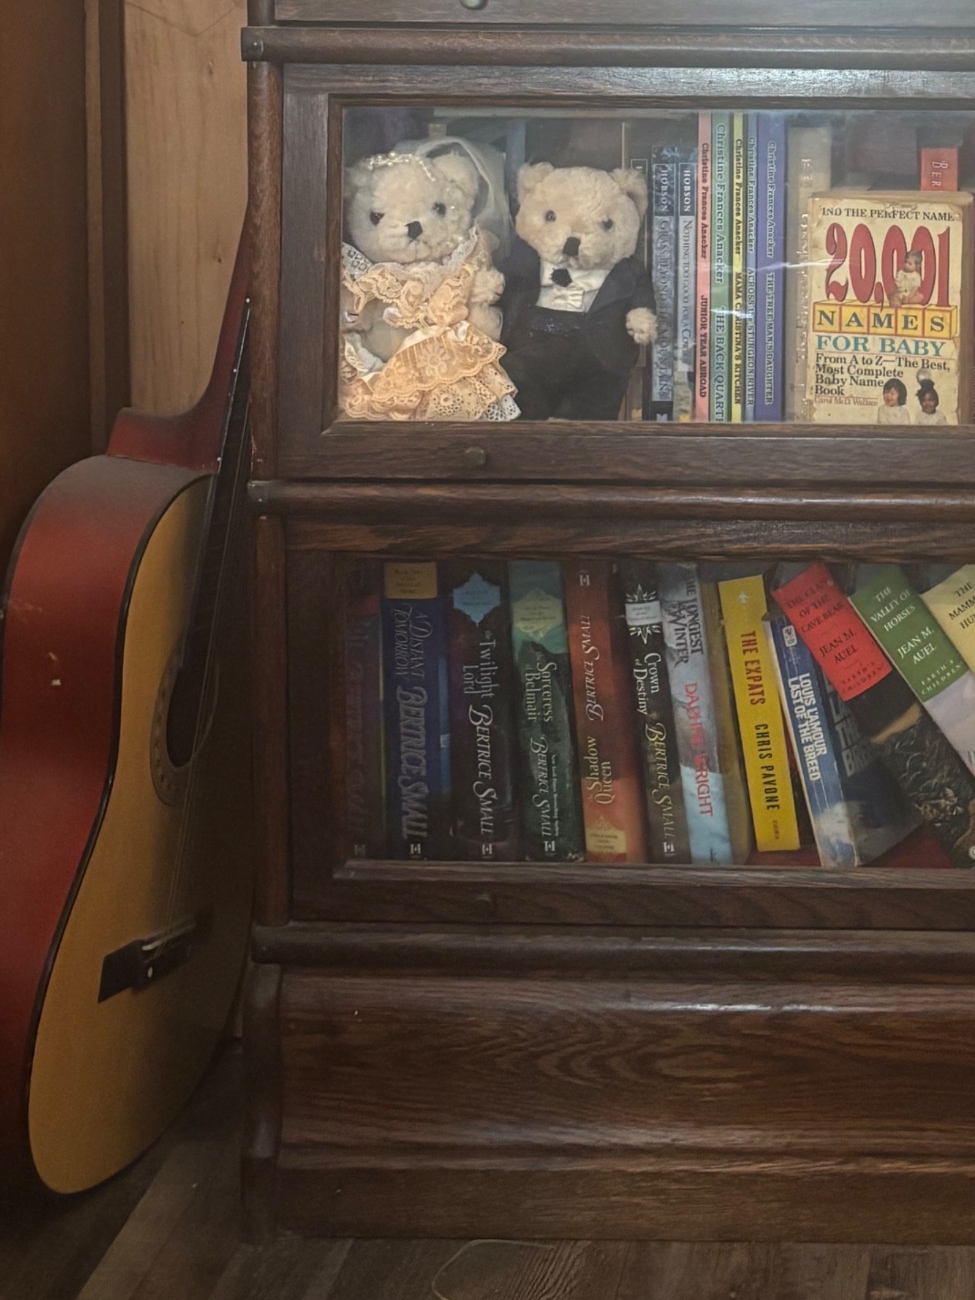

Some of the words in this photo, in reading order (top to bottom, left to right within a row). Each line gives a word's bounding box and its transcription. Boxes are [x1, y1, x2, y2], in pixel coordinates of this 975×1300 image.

[717, 124, 726, 180] Christine
[683, 169, 691, 212] HOBSON
[716, 183, 725, 231] Frances
[845, 209, 867, 217] THE
[870, 209, 920, 220] PERFECT
[716, 234, 725, 284] Anacker
[826, 223, 951, 312] 20,001
[766, 272, 775, 293] THE
[817, 310, 945, 333] NAMES
[714, 338, 725, 372] BACK
[815, 335, 870, 351] FOR
[880, 336, 946, 357] BABY
[815, 353, 847, 364] From
[850, 354, 859, 364] A
[862, 356, 873, 365] to
[921, 358, 950, 372] Best,
[699, 358, 707, 398] ABROAD
[765, 354, 774, 405] DAUGHTER
[815, 363, 844, 375] Most
[847, 365, 904, 378] Complete
[815, 374, 847, 387] Baby
[849, 376, 885, 387] Name
[815, 385, 845, 396] Book
[875, 586, 892, 603] THE
[954, 582, 973, 597] THE
[801, 618, 821, 633] CAVE
[870, 597, 900, 623] VALLEY
[883, 605, 916, 632] HORSES
[685, 603, 703, 655] LONGEST
[740, 631, 757, 654] THE
[897, 635, 922, 659] JEAN
[921, 626, 935, 640] M.
[819, 637, 843, 657] JEAN
[834, 644, 858, 664] AUEL
[912, 643, 937, 665] AUEL
[463, 665, 479, 694] Lord
[479, 639, 499, 698] Twilight
[644, 652, 662, 693] Crown
[744, 659, 766, 707] EXPATS
[633, 669, 650, 715] Destiny
[788, 677, 803, 703] LAST
[799, 673, 817, 708] LOUIS
[794, 703, 807, 719] OF
[397, 686, 428, 776] BERTRICE
[469, 704, 493, 779] BERTRICE
[754, 723, 773, 761] CHRIS
[797, 719, 812, 744] THE
[805, 708, 828, 756] L'AMOUR
[584, 736, 600, 791] Shadow
[645, 722, 667, 790] BERTRICE
[803, 743, 821, 782] BREED
[760, 764, 780, 811] PAVONE
[473, 781, 498, 834] SMALL
[652, 789, 675, 840] SMALL
